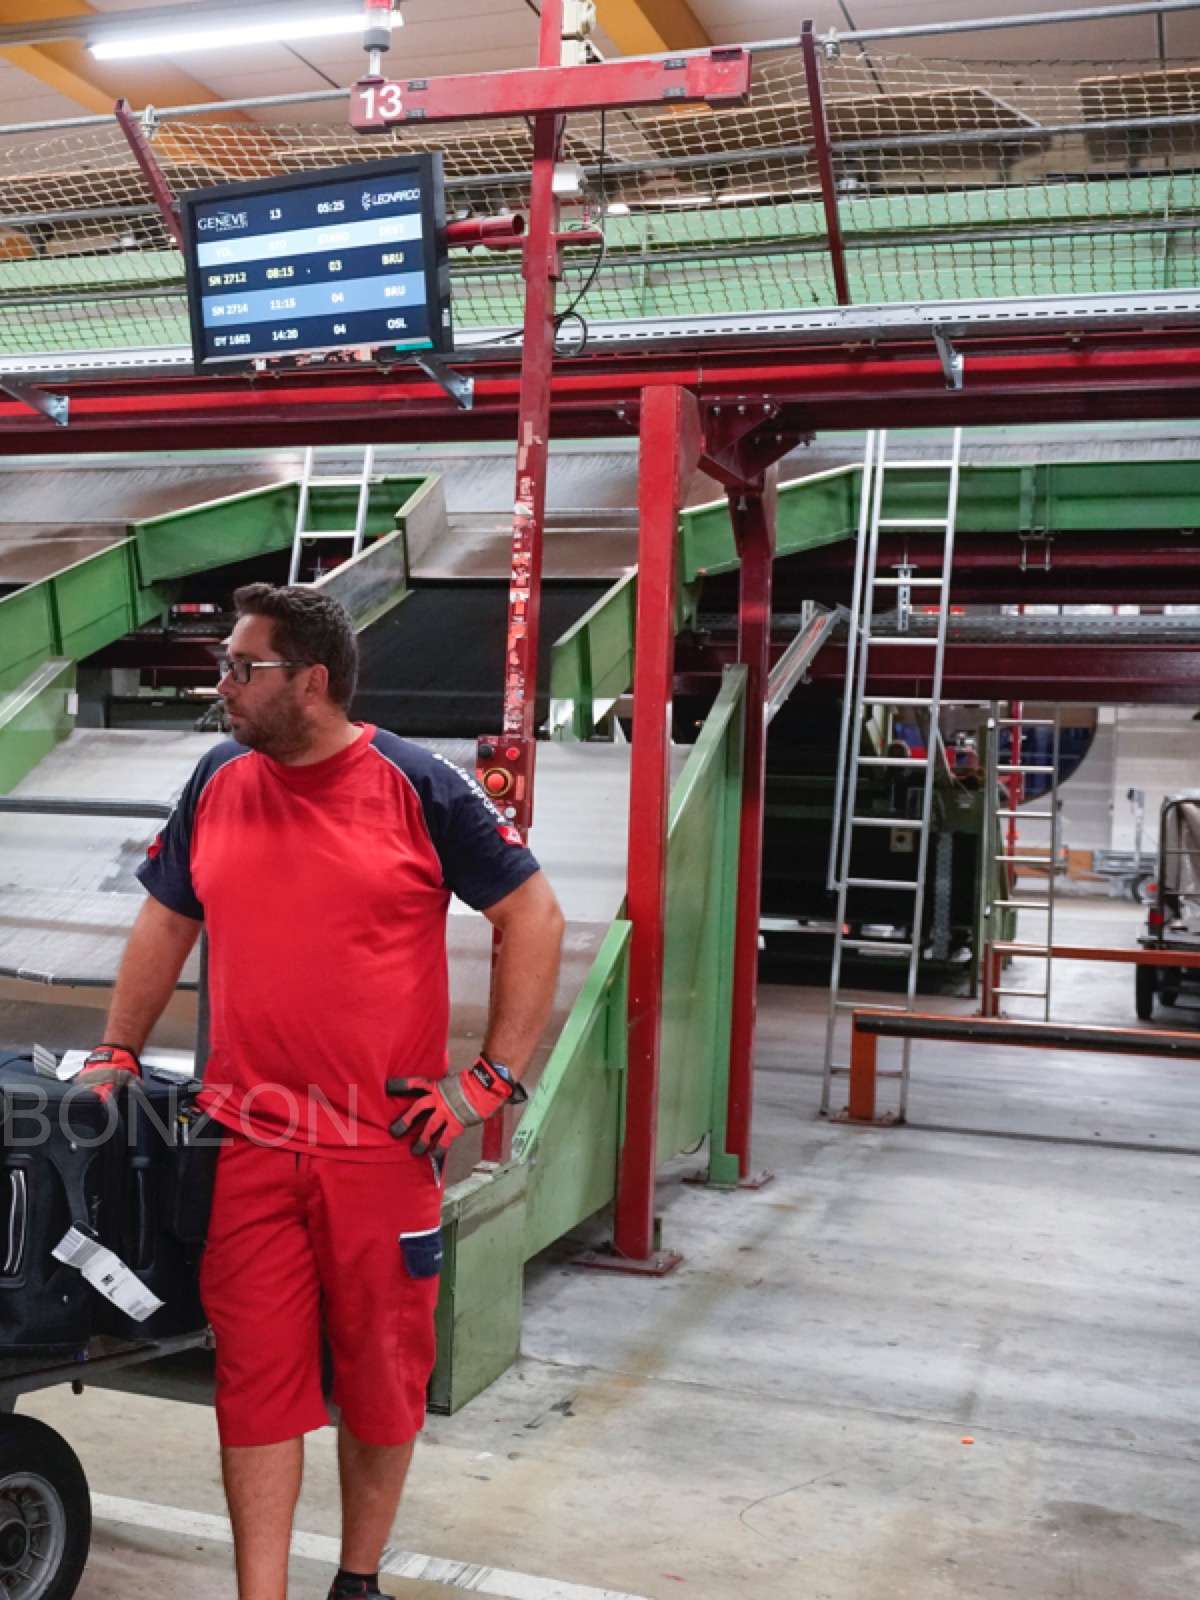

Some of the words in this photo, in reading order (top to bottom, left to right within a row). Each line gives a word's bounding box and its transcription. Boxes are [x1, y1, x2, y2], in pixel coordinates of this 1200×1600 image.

[359, 84, 403, 119] 13
[269, 208, 282, 221] 13
[317, 199, 345, 215] 05:25
[381, 251, 405, 265] BRU
[383, 285, 406, 298] BRU
